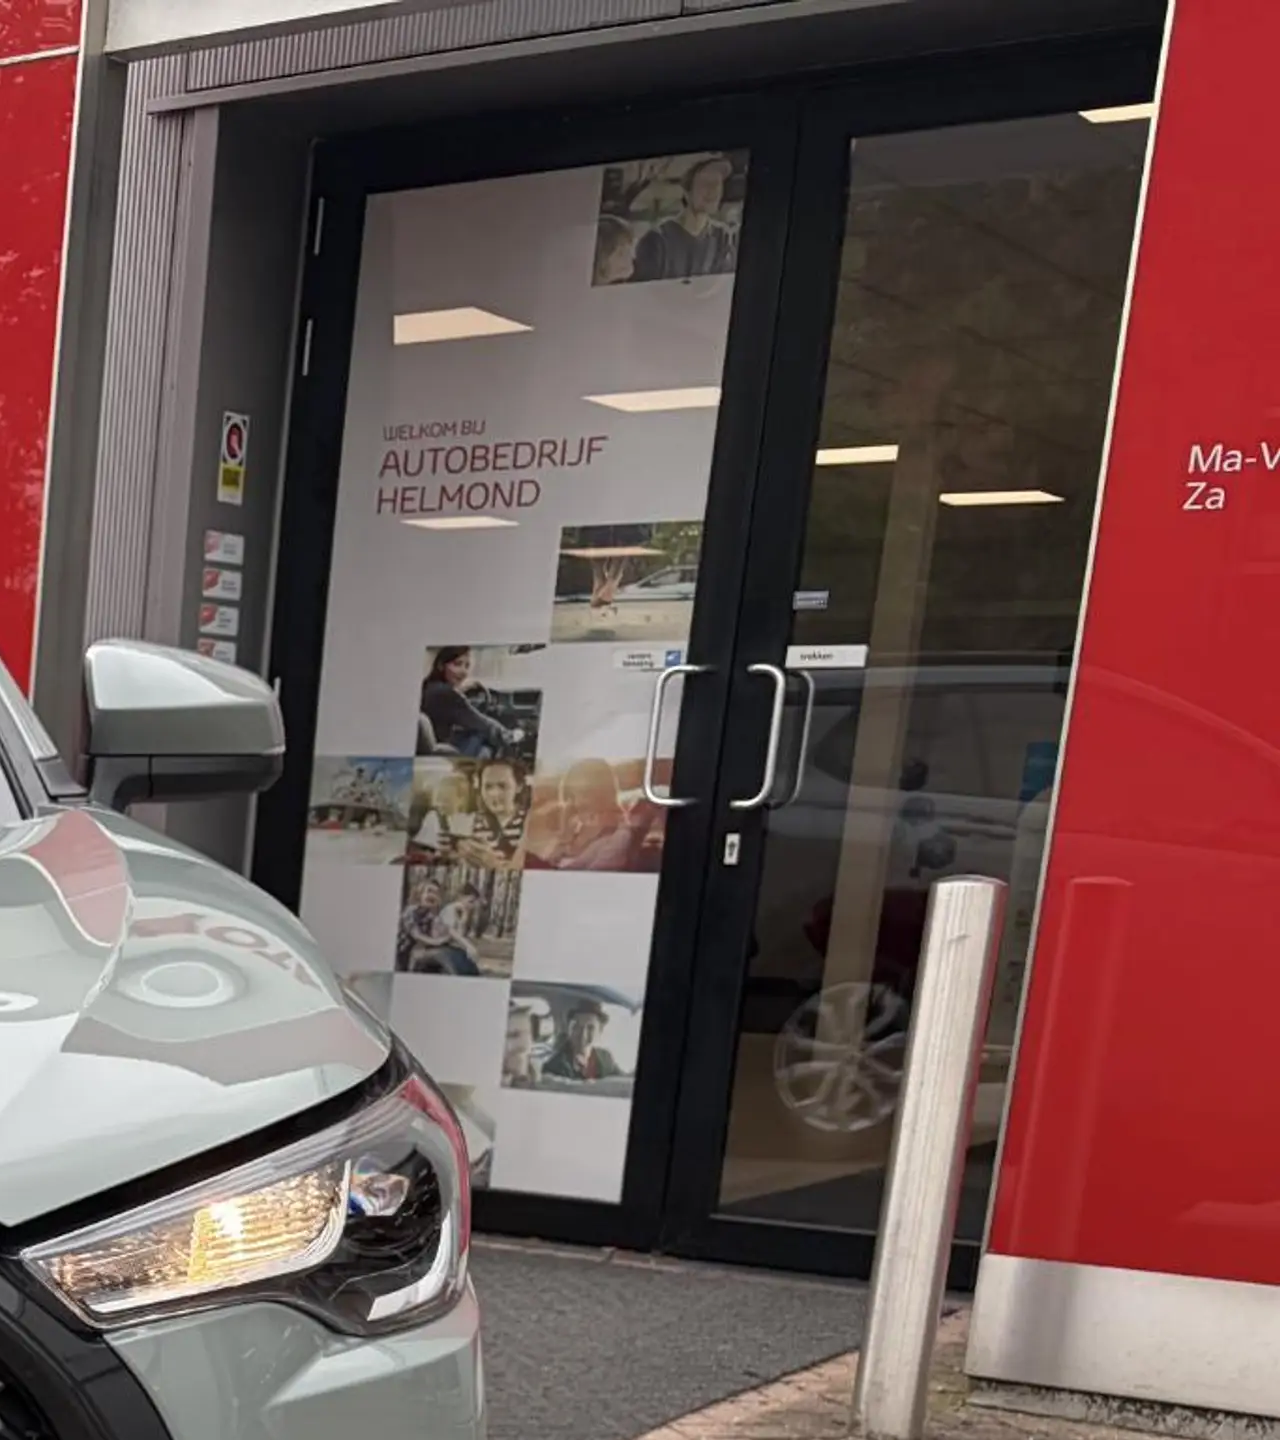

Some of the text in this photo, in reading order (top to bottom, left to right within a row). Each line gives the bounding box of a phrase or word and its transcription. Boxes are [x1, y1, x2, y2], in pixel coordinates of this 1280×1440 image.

[383, 418, 487, 442] WELKOM BIJ
[378, 435, 609, 479] AUTOBEDRIJF
[376, 479, 542, 515] HELMOND
[1182, 481, 1225, 510] Za
